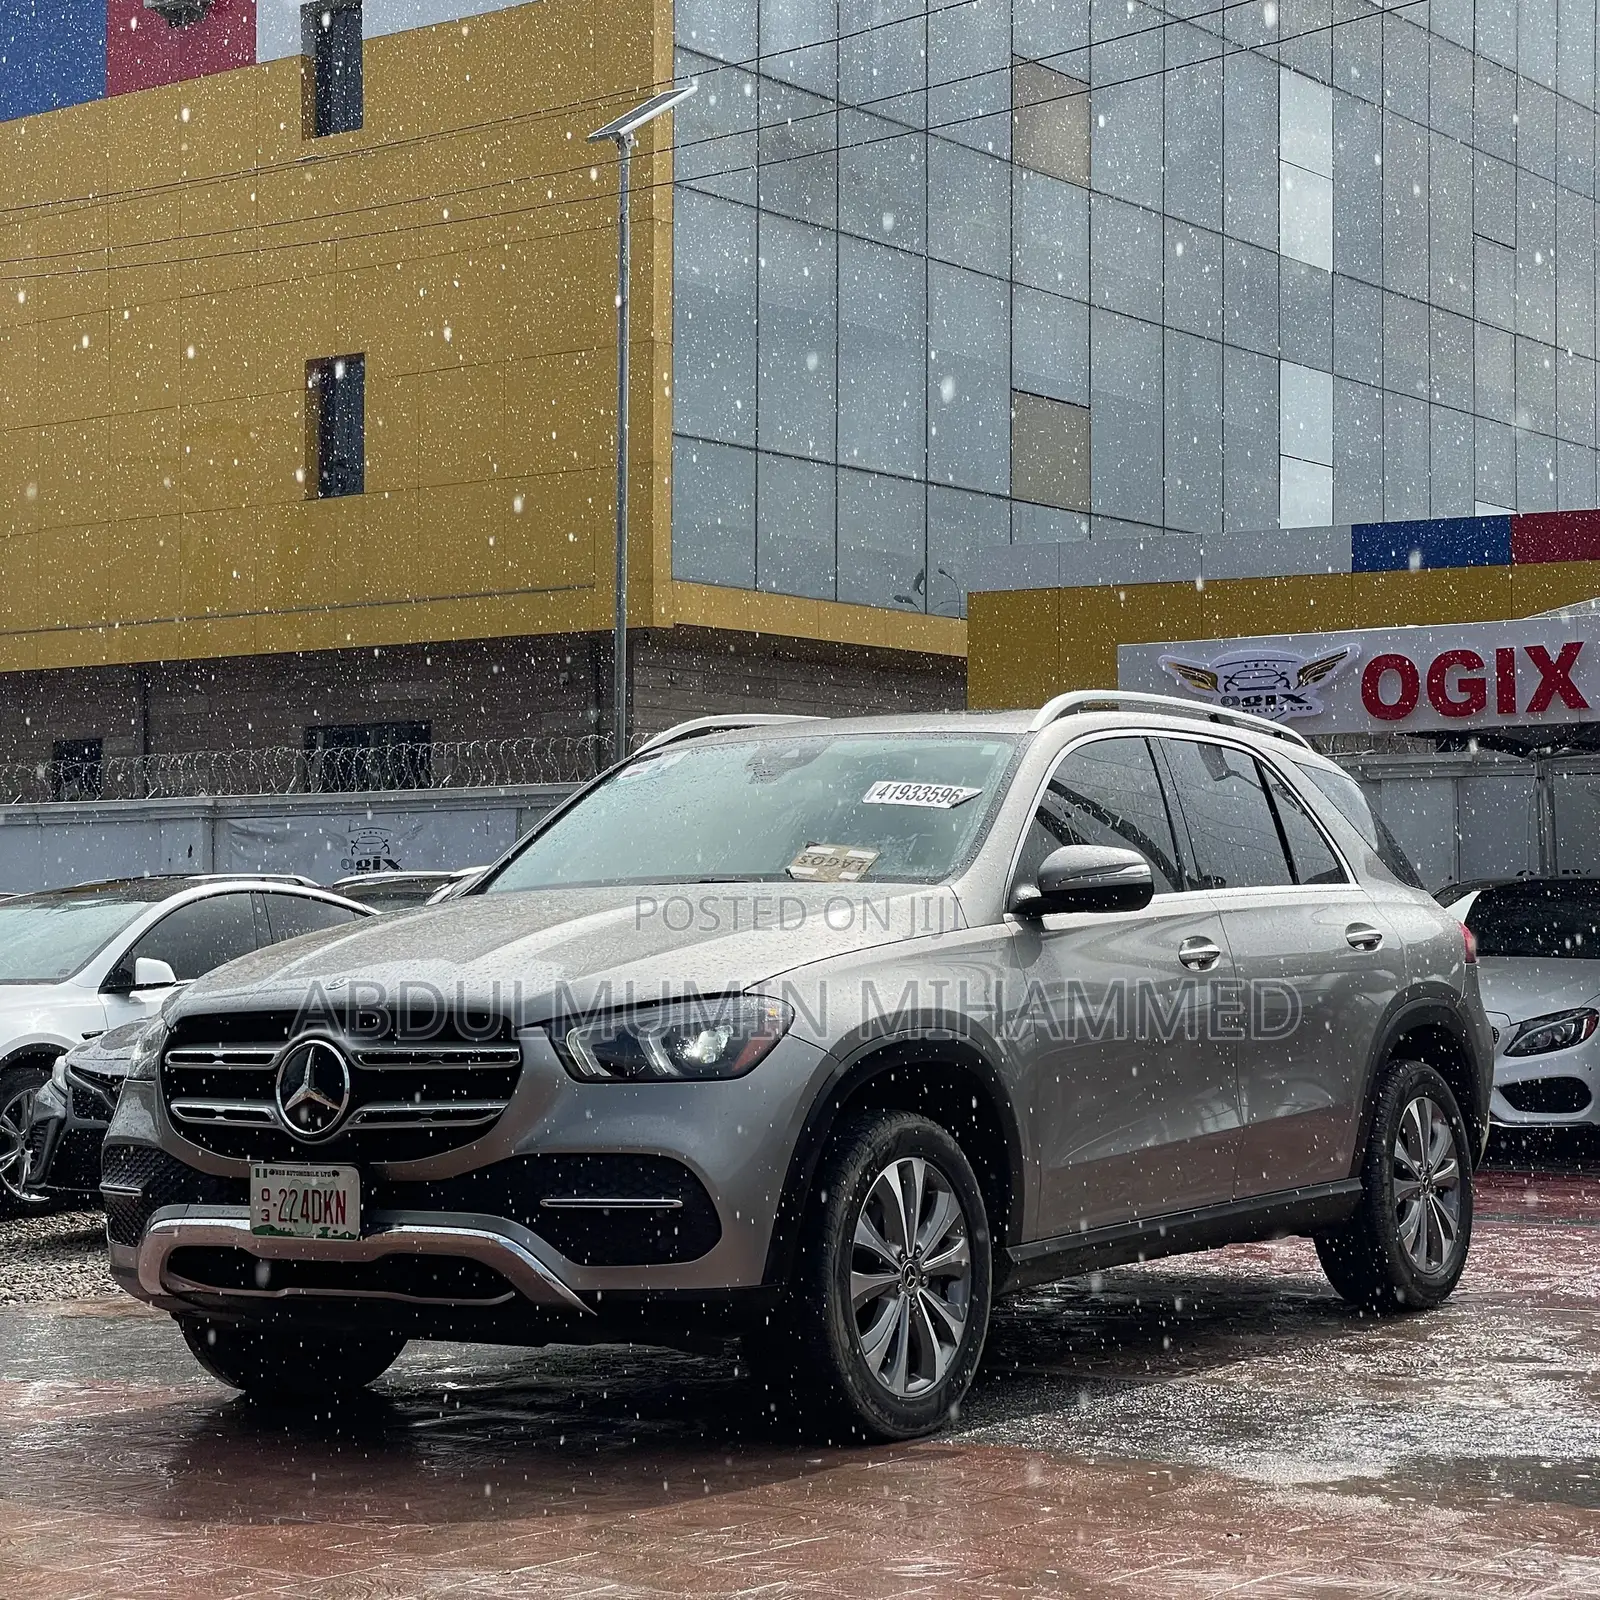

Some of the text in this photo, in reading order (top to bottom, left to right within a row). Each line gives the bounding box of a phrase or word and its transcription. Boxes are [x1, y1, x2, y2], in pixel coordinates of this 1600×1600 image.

[1361, 641, 1590, 720] OGIX
[876, 784, 964, 804] 41933596
[798, 855, 867, 871] LAGOS
[278, 1188, 346, 1225] 224DKN
